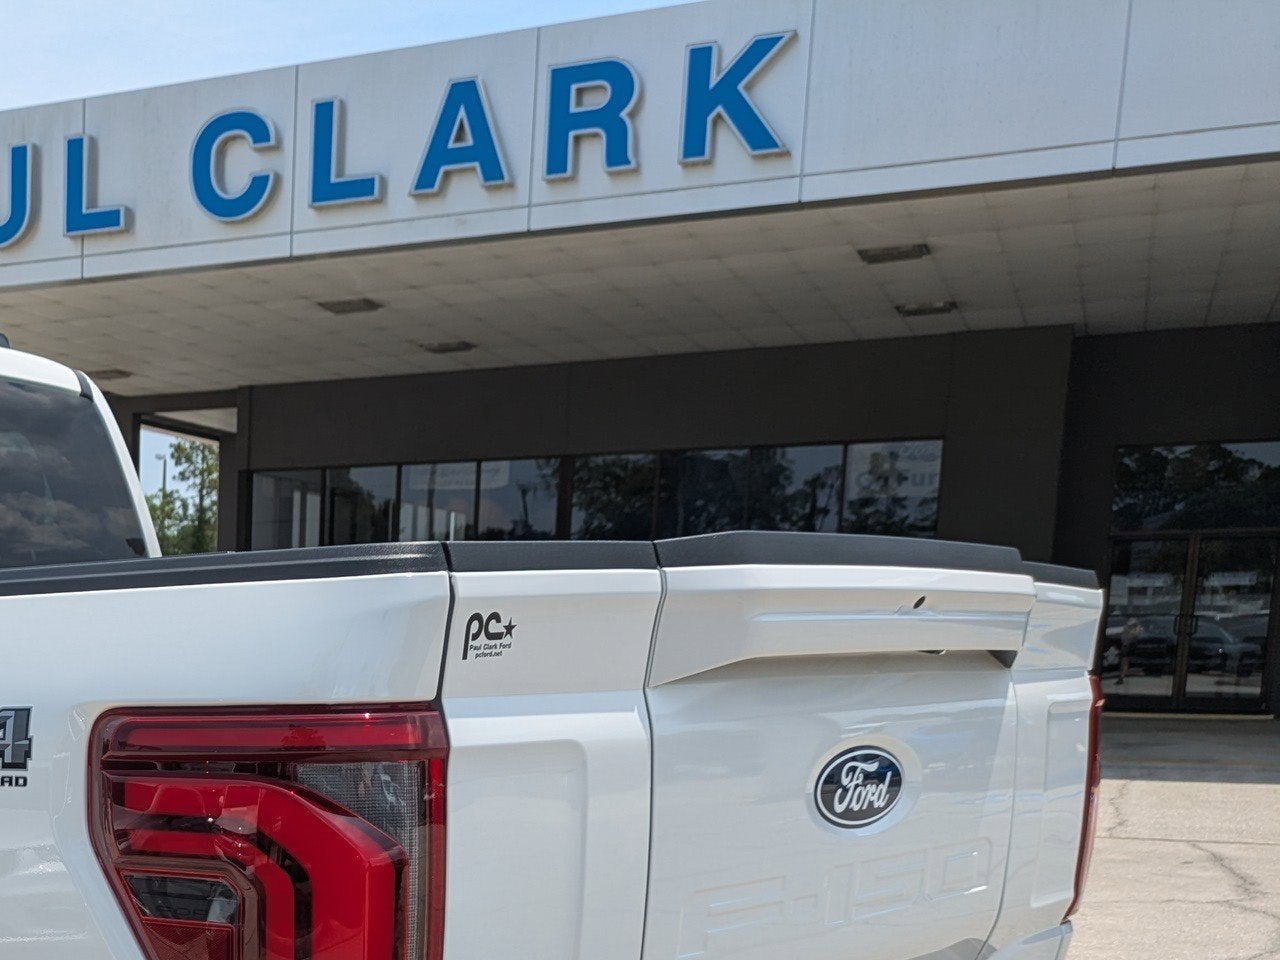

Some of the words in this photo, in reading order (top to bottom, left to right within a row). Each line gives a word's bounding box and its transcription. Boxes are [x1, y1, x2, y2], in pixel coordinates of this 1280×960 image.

[190, 30, 798, 222] CLARK
[475, 651, 503, 659] pcford.net
[499, 642, 513, 650] Ford
[833, 761, 893, 814] Ford
